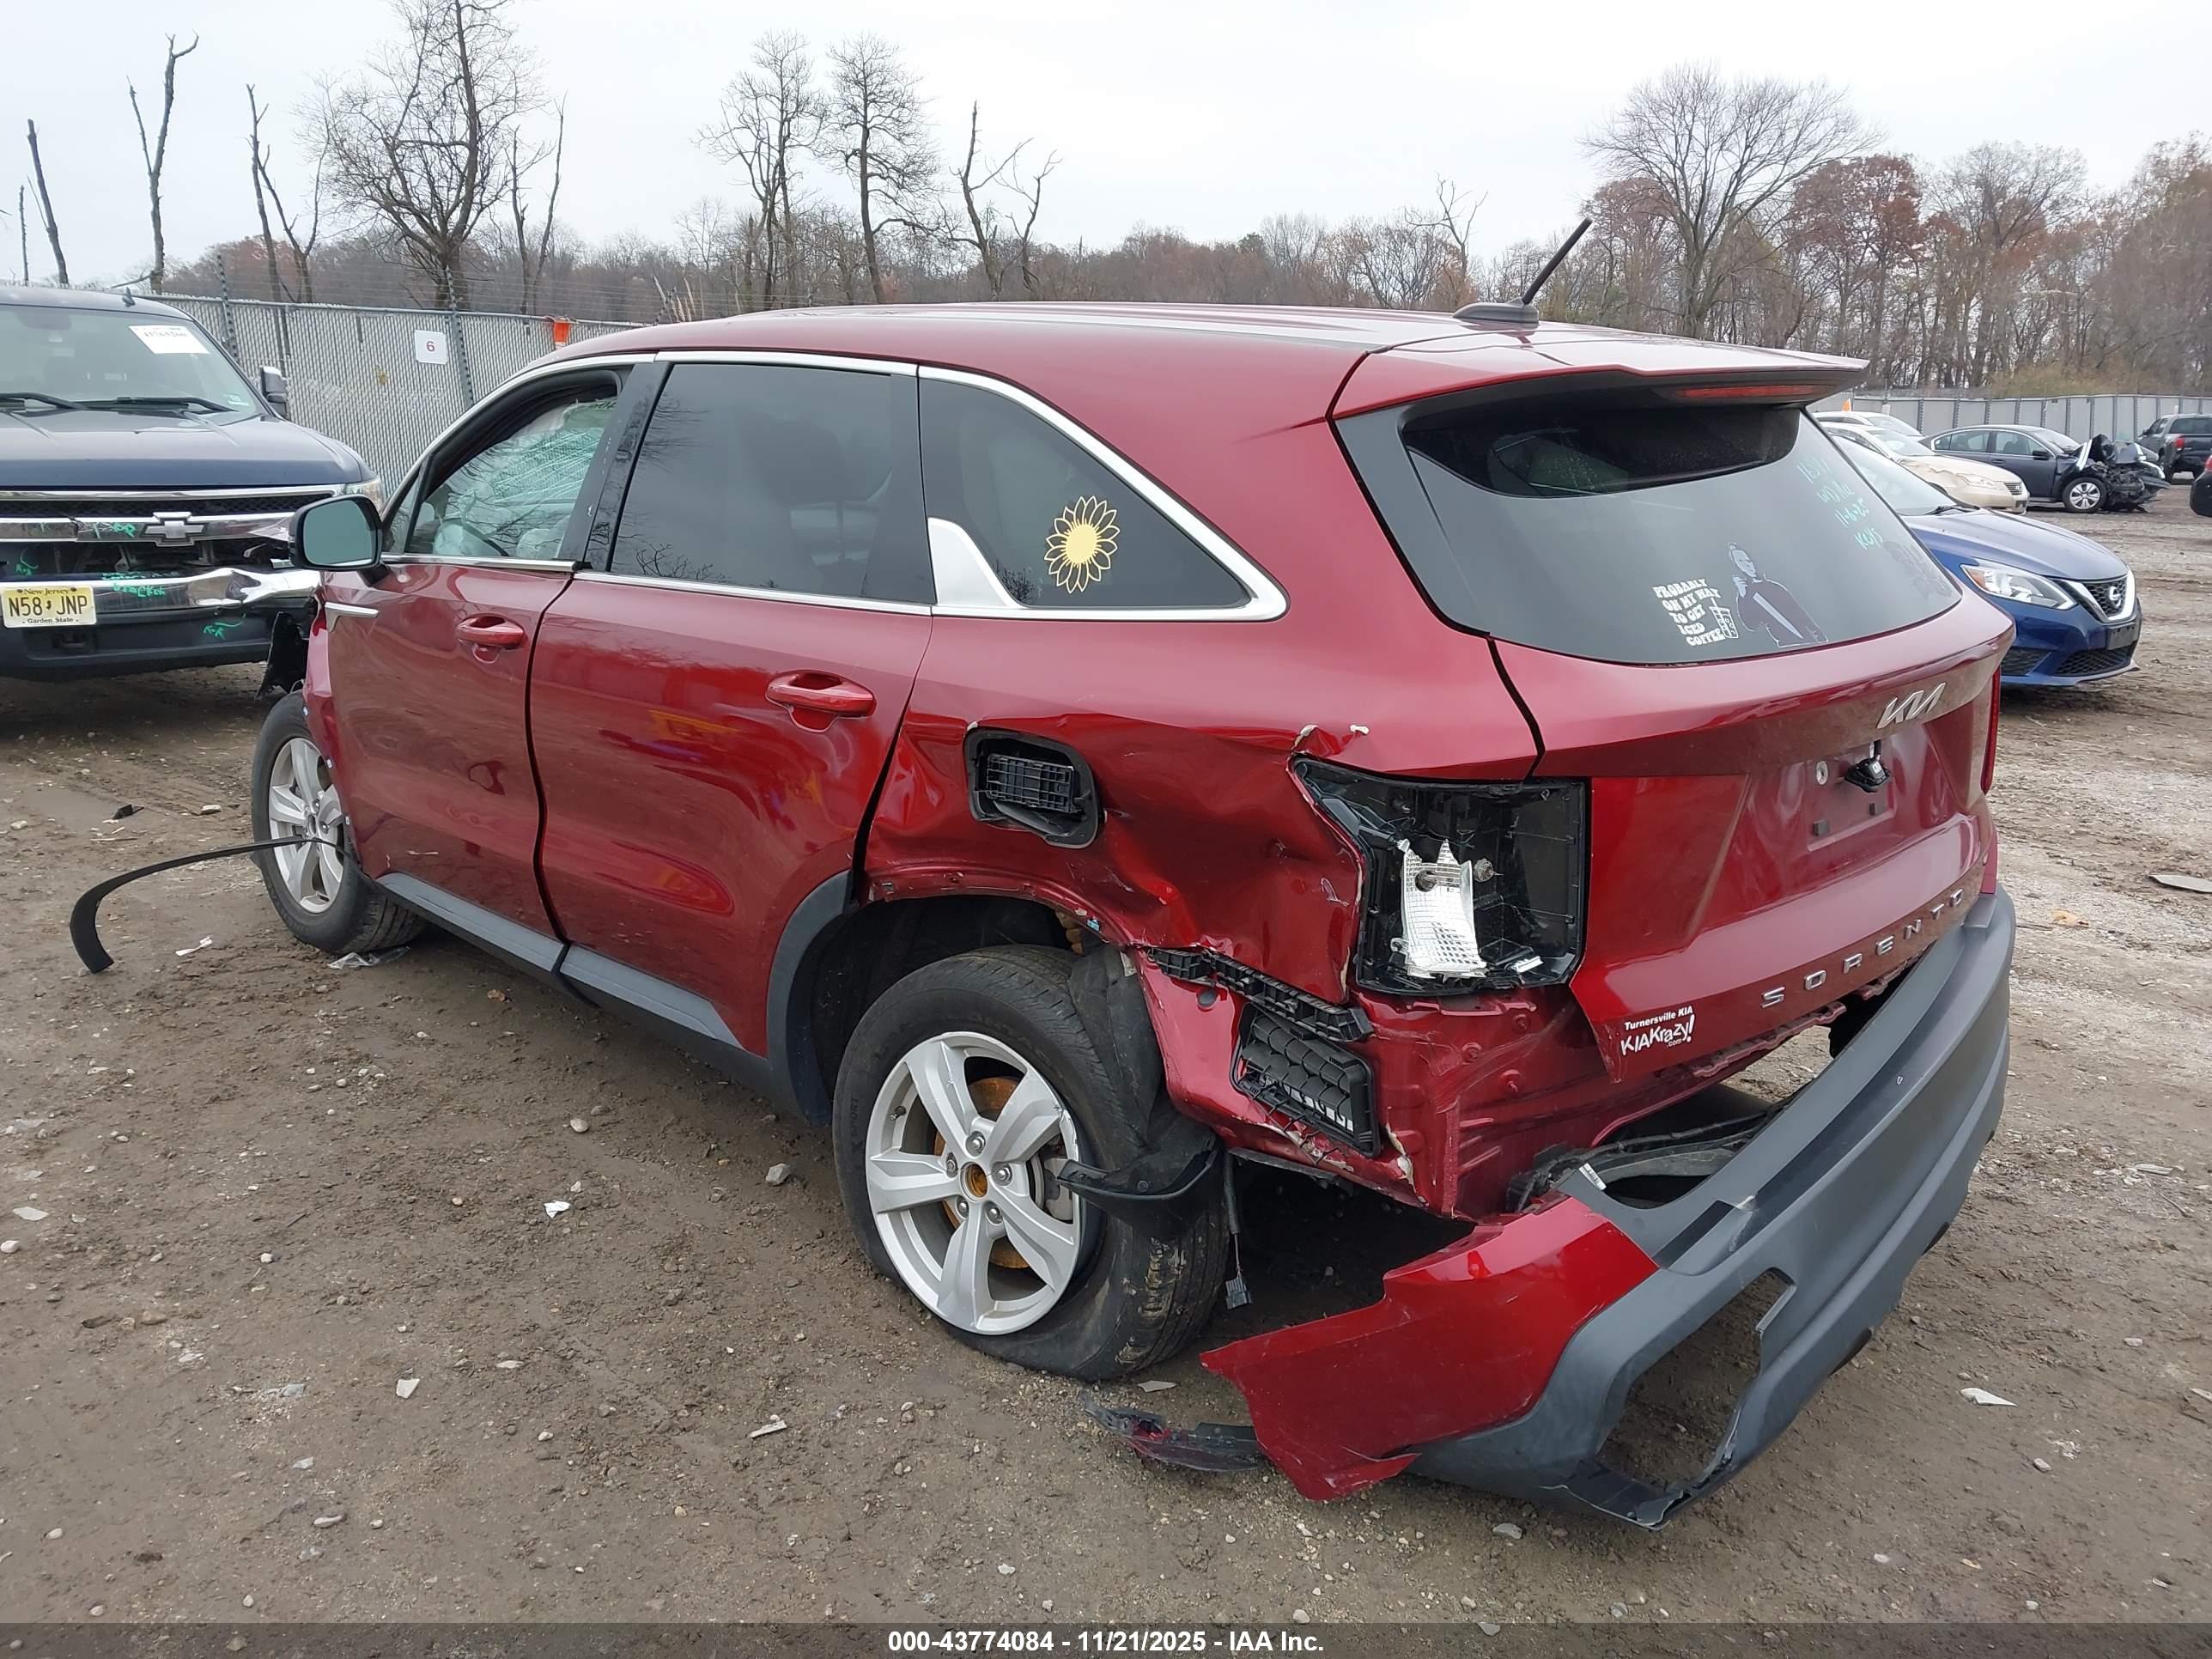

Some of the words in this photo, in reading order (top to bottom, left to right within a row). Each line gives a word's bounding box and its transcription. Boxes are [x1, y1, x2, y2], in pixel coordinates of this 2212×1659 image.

[426, 340, 435, 352] 6
[44, 587, 70, 596] Jersey
[1652, 578, 1708, 599] PROBABLY
[1662, 599, 1683, 611] ON
[1682, 592, 1697, 607] MY
[1695, 586, 1722, 600] WAY
[8, 597, 43, 617] N58
[56, 595, 88, 616] JNP
[1669, 612, 1687, 624] TO
[1687, 604, 1706, 623] GET
[1678, 623, 1705, 635] ICED
[1686, 628, 1726, 647] COFFEE
[1760, 888, 1964, 1009] SORENTO
[1624, 1012, 1676, 1031] Turnersville
[1677, 1006, 1693, 1018] KIA
